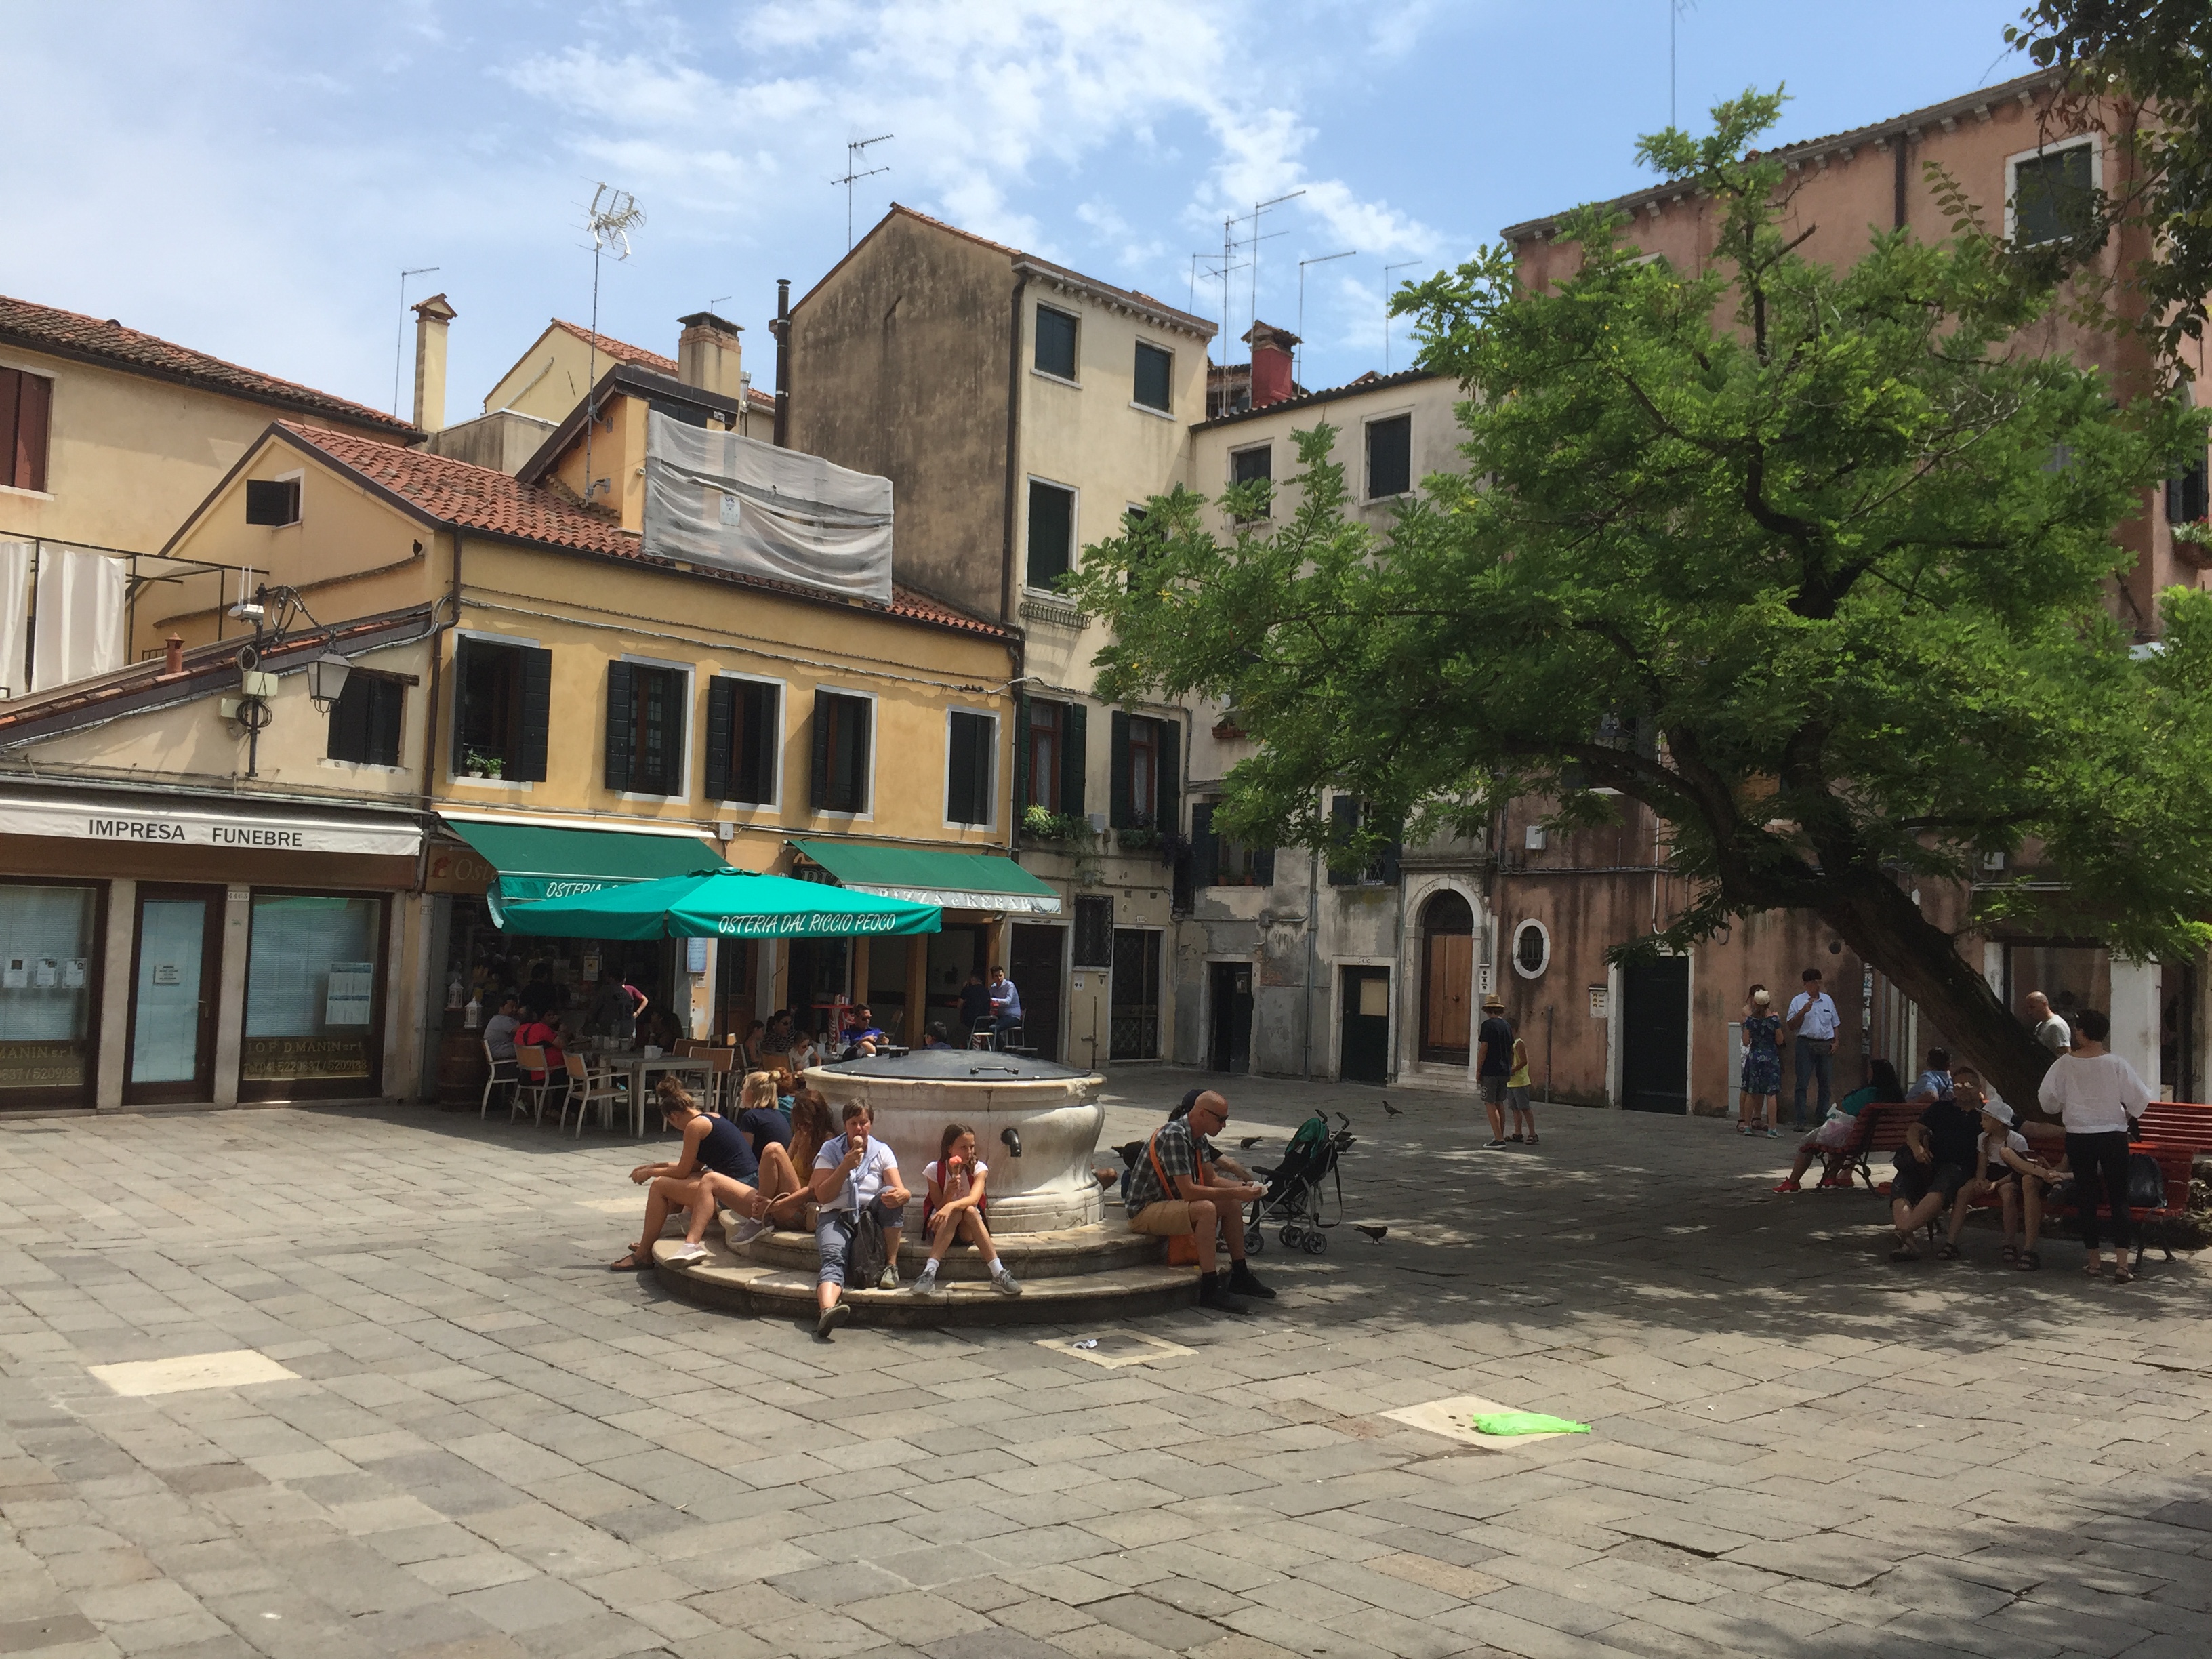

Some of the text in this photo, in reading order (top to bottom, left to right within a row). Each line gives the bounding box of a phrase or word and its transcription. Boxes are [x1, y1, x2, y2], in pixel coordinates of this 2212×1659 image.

[89, 819, 303, 846] IMPRESA FUNEBRE
[965, 893, 1032, 909] KEBAB
[718, 914, 895, 933] OSTERIA DAL RICCIO PEOCO
[296, 1041, 340, 1052] MANIN
[0, 1068, 24, 1080] 637
